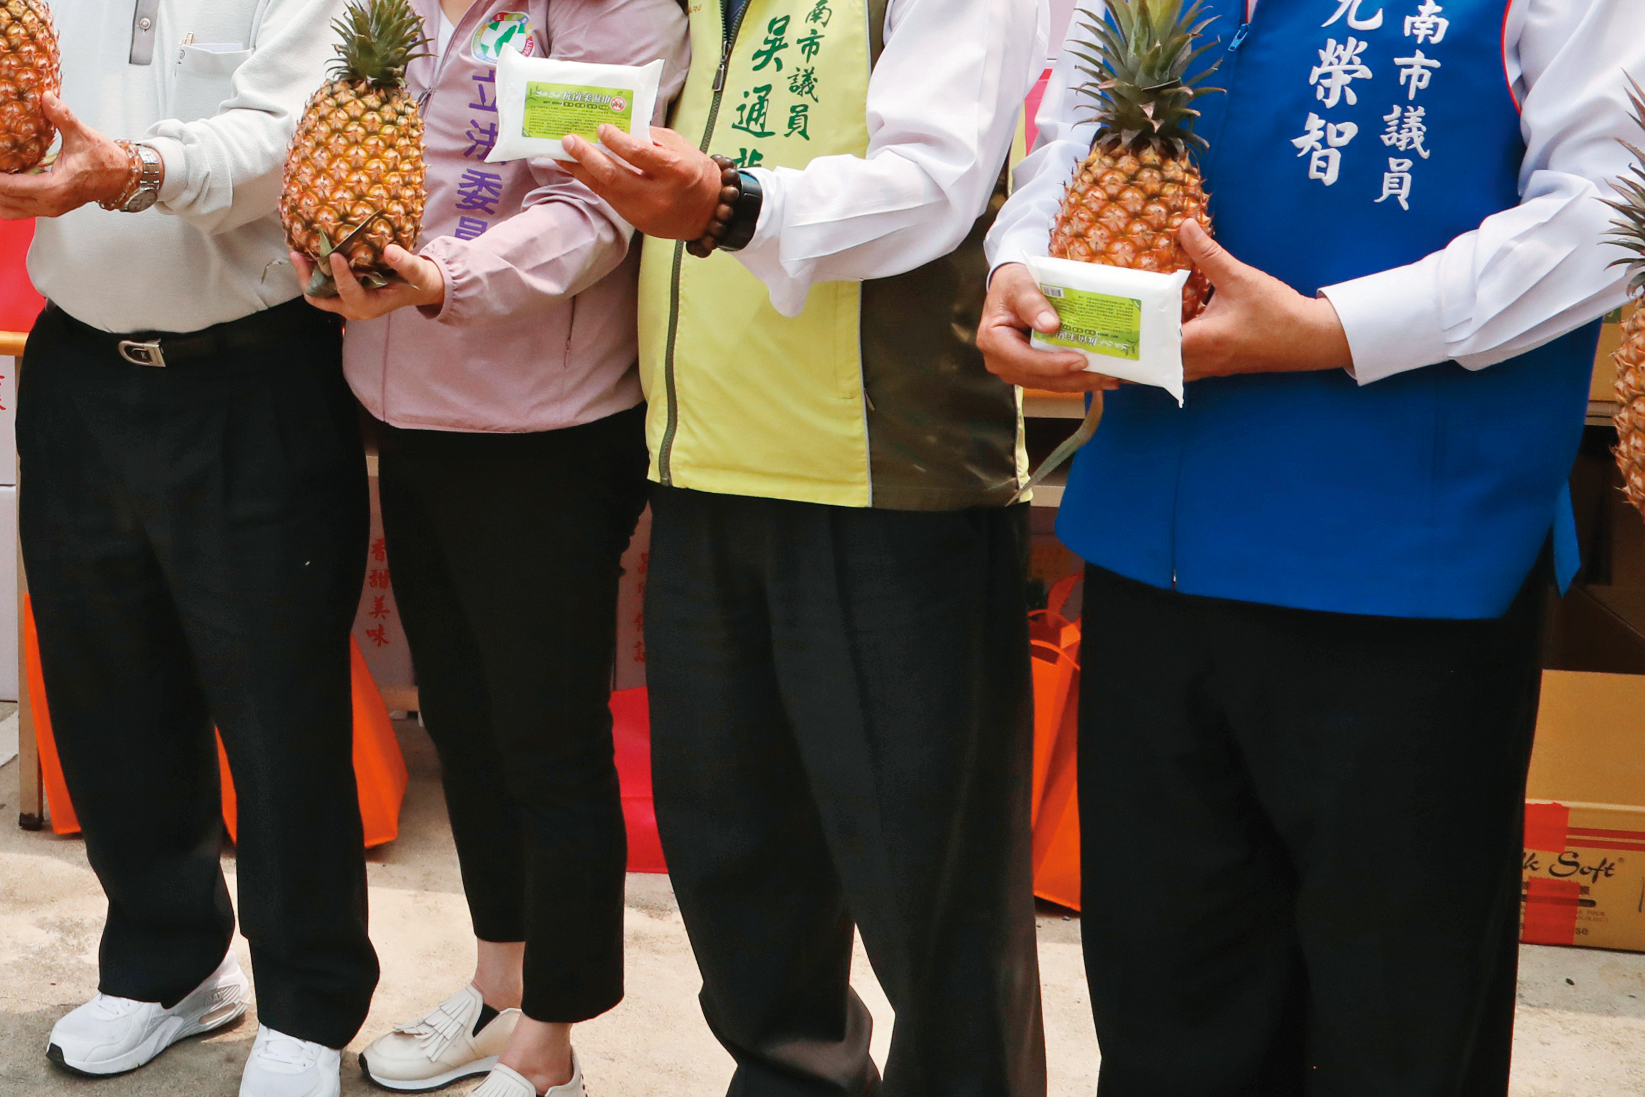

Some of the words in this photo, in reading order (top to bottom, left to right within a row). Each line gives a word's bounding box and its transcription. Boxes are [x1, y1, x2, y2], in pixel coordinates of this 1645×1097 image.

[366, 538, 391, 648] 香甜美味
[1548, 851, 1615, 884] Soft
